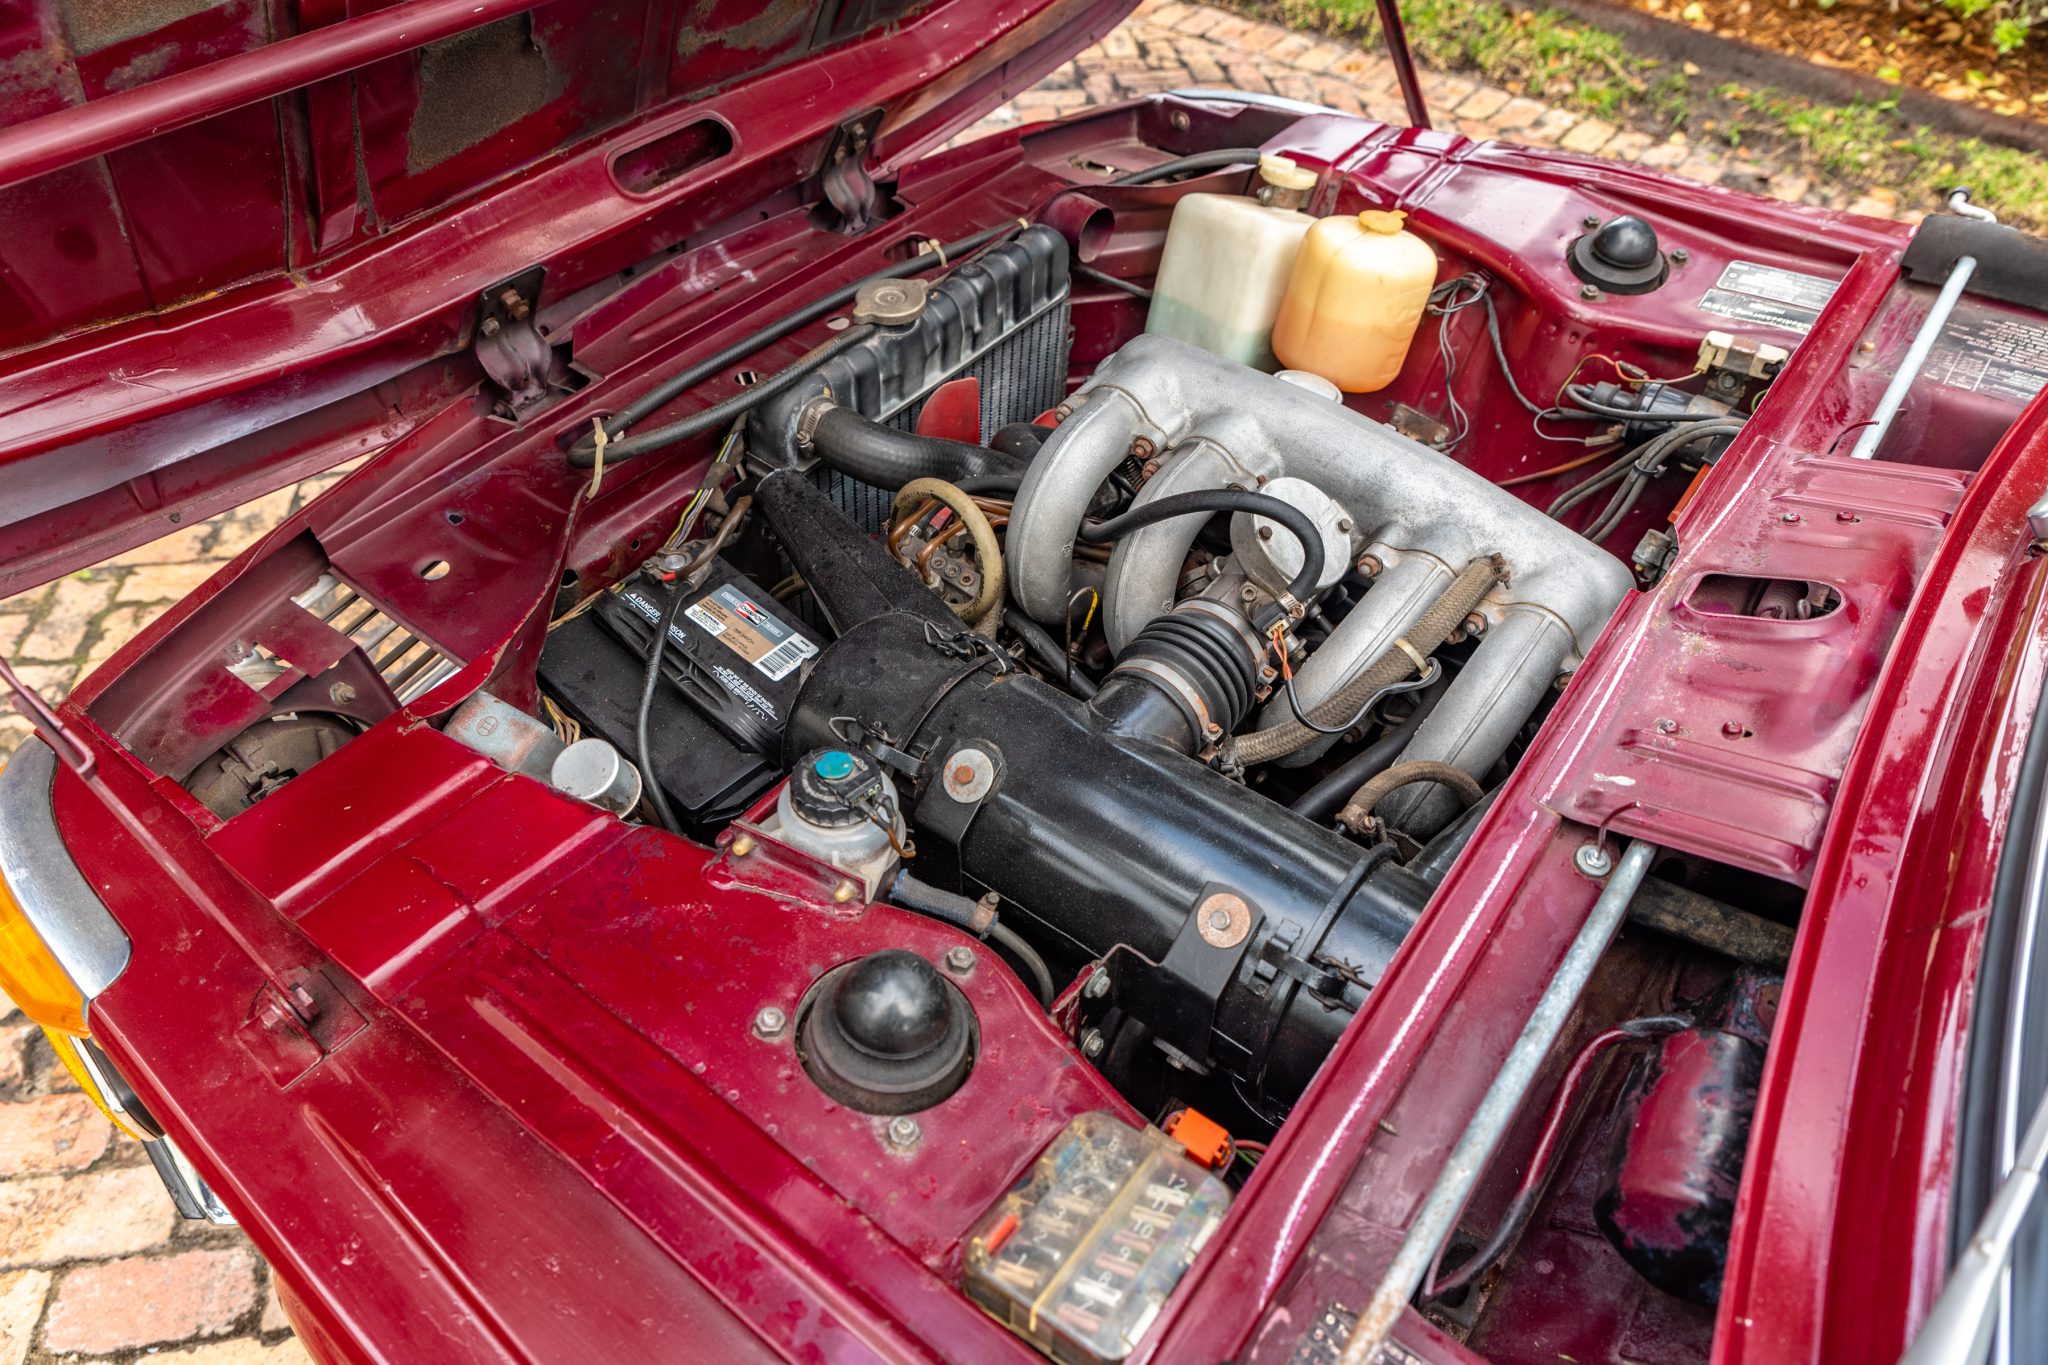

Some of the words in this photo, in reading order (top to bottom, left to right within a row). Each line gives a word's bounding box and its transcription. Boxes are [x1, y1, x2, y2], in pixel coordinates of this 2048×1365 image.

[635, 596, 661, 618] DANGER
[669, 622, 687, 639] ISON
[740, 604, 763, 622] CHAMPION
[1167, 1173, 1188, 1194] 12
[1052, 1205, 1067, 1219] 3
[1152, 1196, 1169, 1213] 11
[1032, 1229, 1048, 1243] 2
[1133, 1218, 1154, 1239] 10
[1016, 1253, 1027, 1266] 1
[1120, 1246, 1132, 1261] 9
